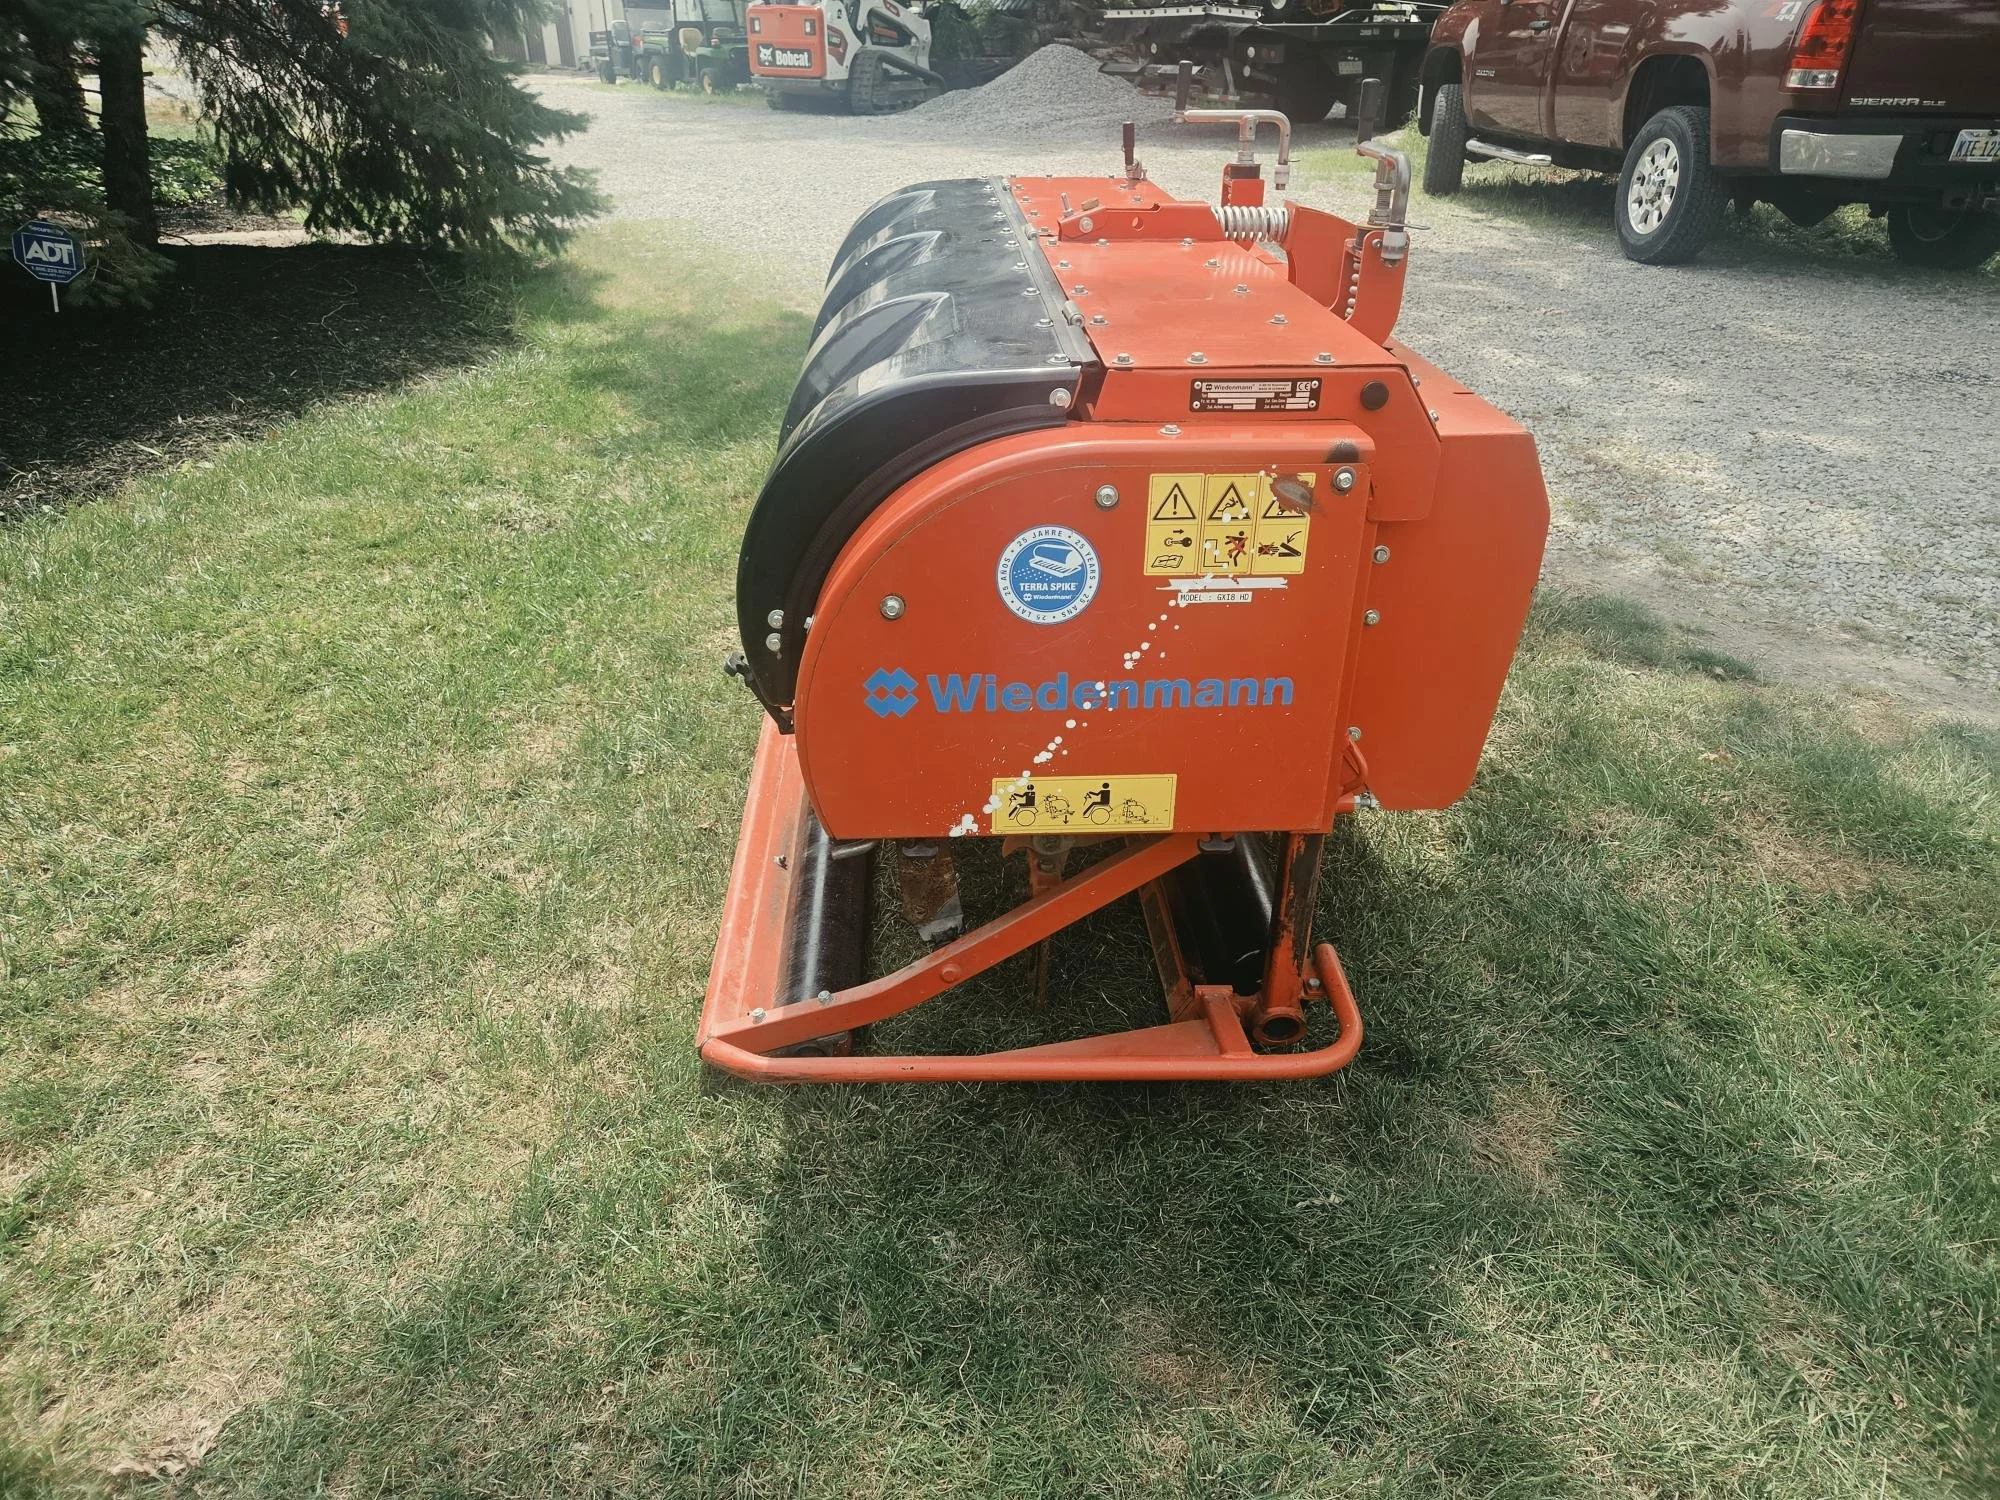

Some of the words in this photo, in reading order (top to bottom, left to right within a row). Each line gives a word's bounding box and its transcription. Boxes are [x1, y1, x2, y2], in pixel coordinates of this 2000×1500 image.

[775, 51, 809, 67] Bobcat
[1850, 97, 1920, 106] SIERRA
[26, 240, 72, 264] ADT
[1213, 383, 1253, 391] Wiedenmann
[1298, 382, 1310, 391] CE
[1016, 537, 1028, 547] 25
[1032, 529, 1063, 539] JAHRE
[1074, 539, 1086, 549] 25
[1084, 551, 1096, 580] YEARS
[1002, 585, 1011, 597] 25
[1019, 582, 1049, 591] TERRA
[1050, 582, 1077, 591] SPIKE
[1180, 594, 1203, 602] MODEL
[1239, 593, 1250, 601] HD
[1016, 606, 1032, 618] LAT
[1061, 605, 1078, 618] ANS
[926, 672, 1294, 713] Wiedenmann
